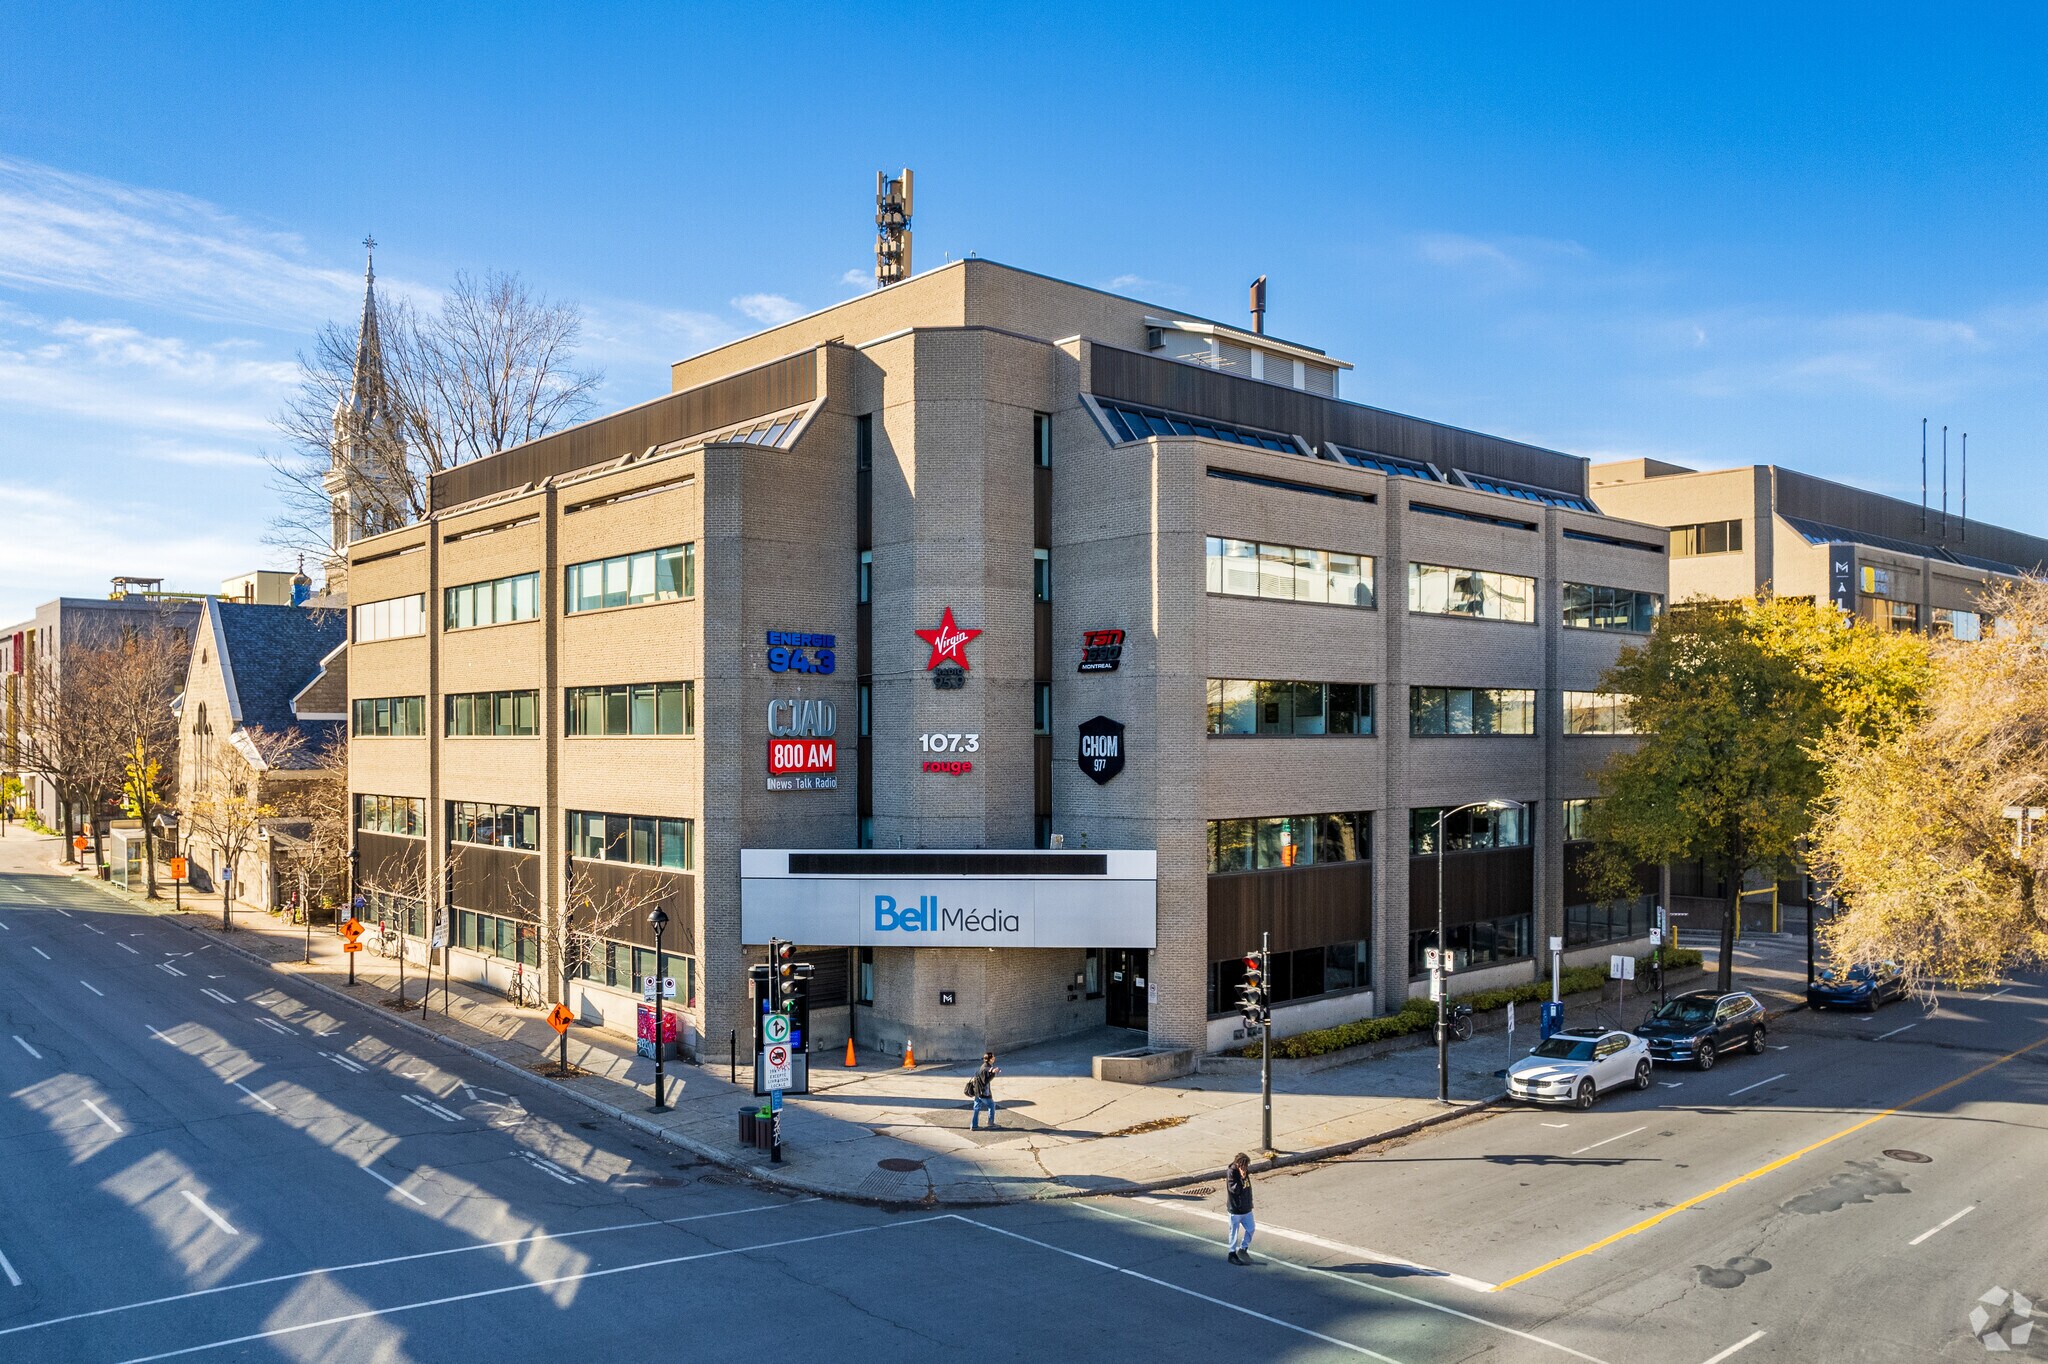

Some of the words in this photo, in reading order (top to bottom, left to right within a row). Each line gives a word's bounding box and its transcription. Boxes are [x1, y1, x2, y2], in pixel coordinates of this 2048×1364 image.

[767, 631, 836, 648] ENERGIE
[935, 626, 969, 656] Virgin
[1083, 629, 1126, 647] TSN
[768, 647, 836, 675] 94.3
[1087, 646, 1122, 661] 690
[933, 667, 964, 676] RADIO
[933, 675, 966, 689] 95.9
[767, 699, 837, 737] CJAD
[919, 733, 980, 753] 107.3
[1082, 735, 1118, 757] CHOM
[774, 744, 804, 769] 800
[807, 744, 833, 768] AM
[922, 761, 972, 776] rouge
[770, 777, 793, 790] News
[795, 777, 812, 789] Talk
[815, 776, 837, 788] Radio
[874, 895, 938, 932] Bell
[942, 908, 1019, 932] Média
